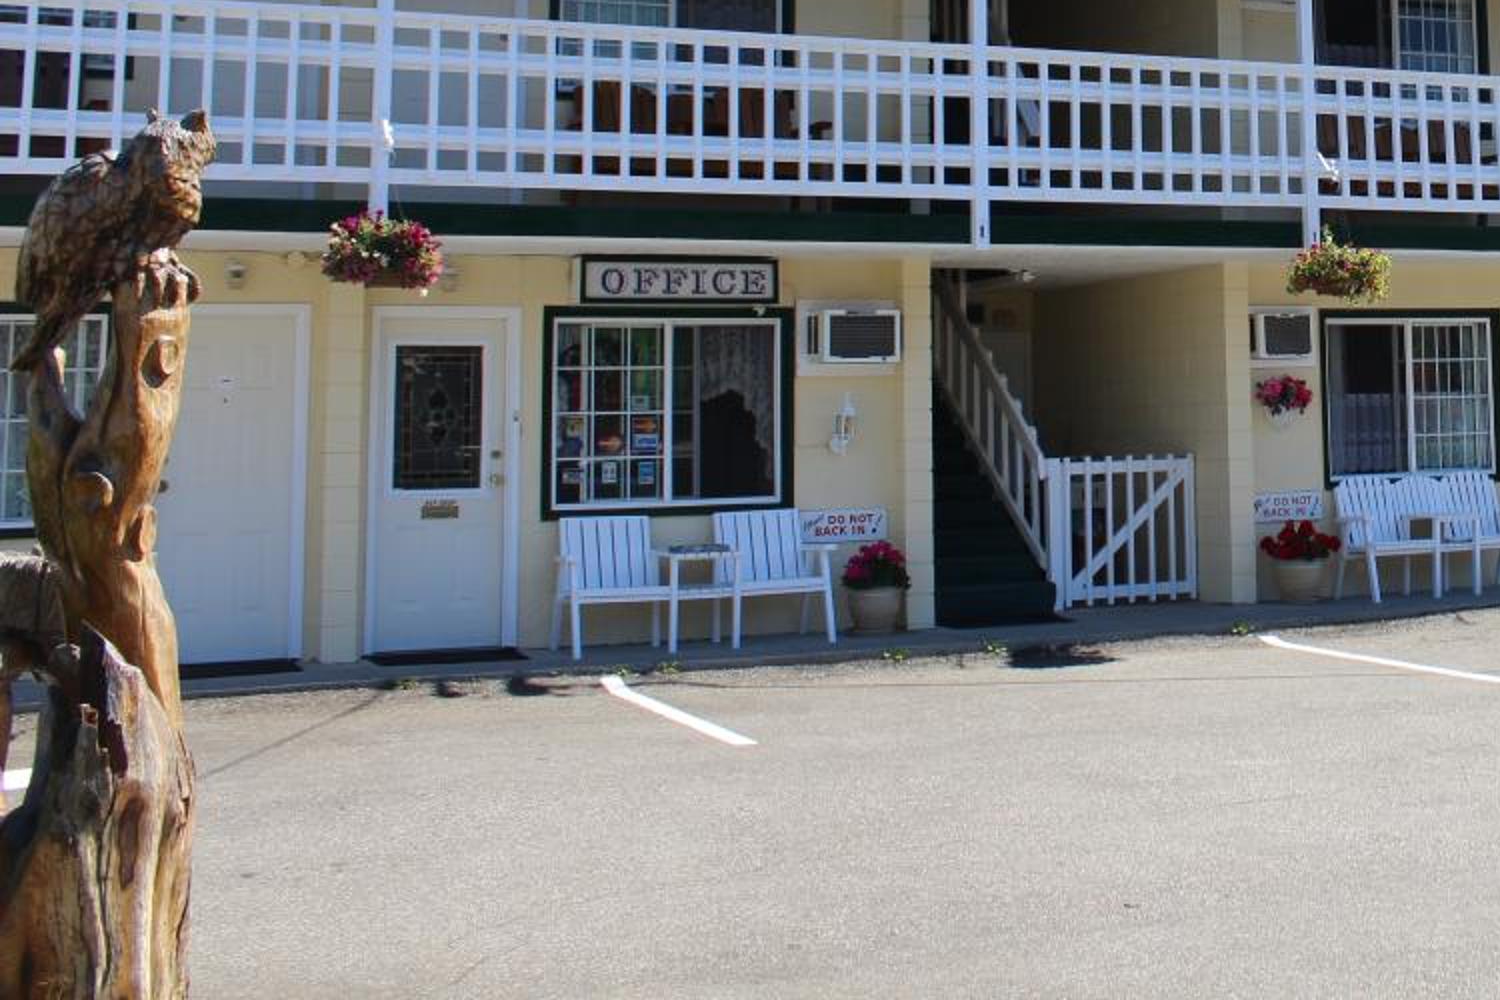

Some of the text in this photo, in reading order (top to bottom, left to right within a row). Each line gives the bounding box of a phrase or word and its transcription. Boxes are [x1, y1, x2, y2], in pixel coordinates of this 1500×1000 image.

[601, 267, 768, 296] OFFICE
[827, 514, 846, 525] DO
[849, 513, 875, 525] NOT
[815, 525, 847, 537] BACK
